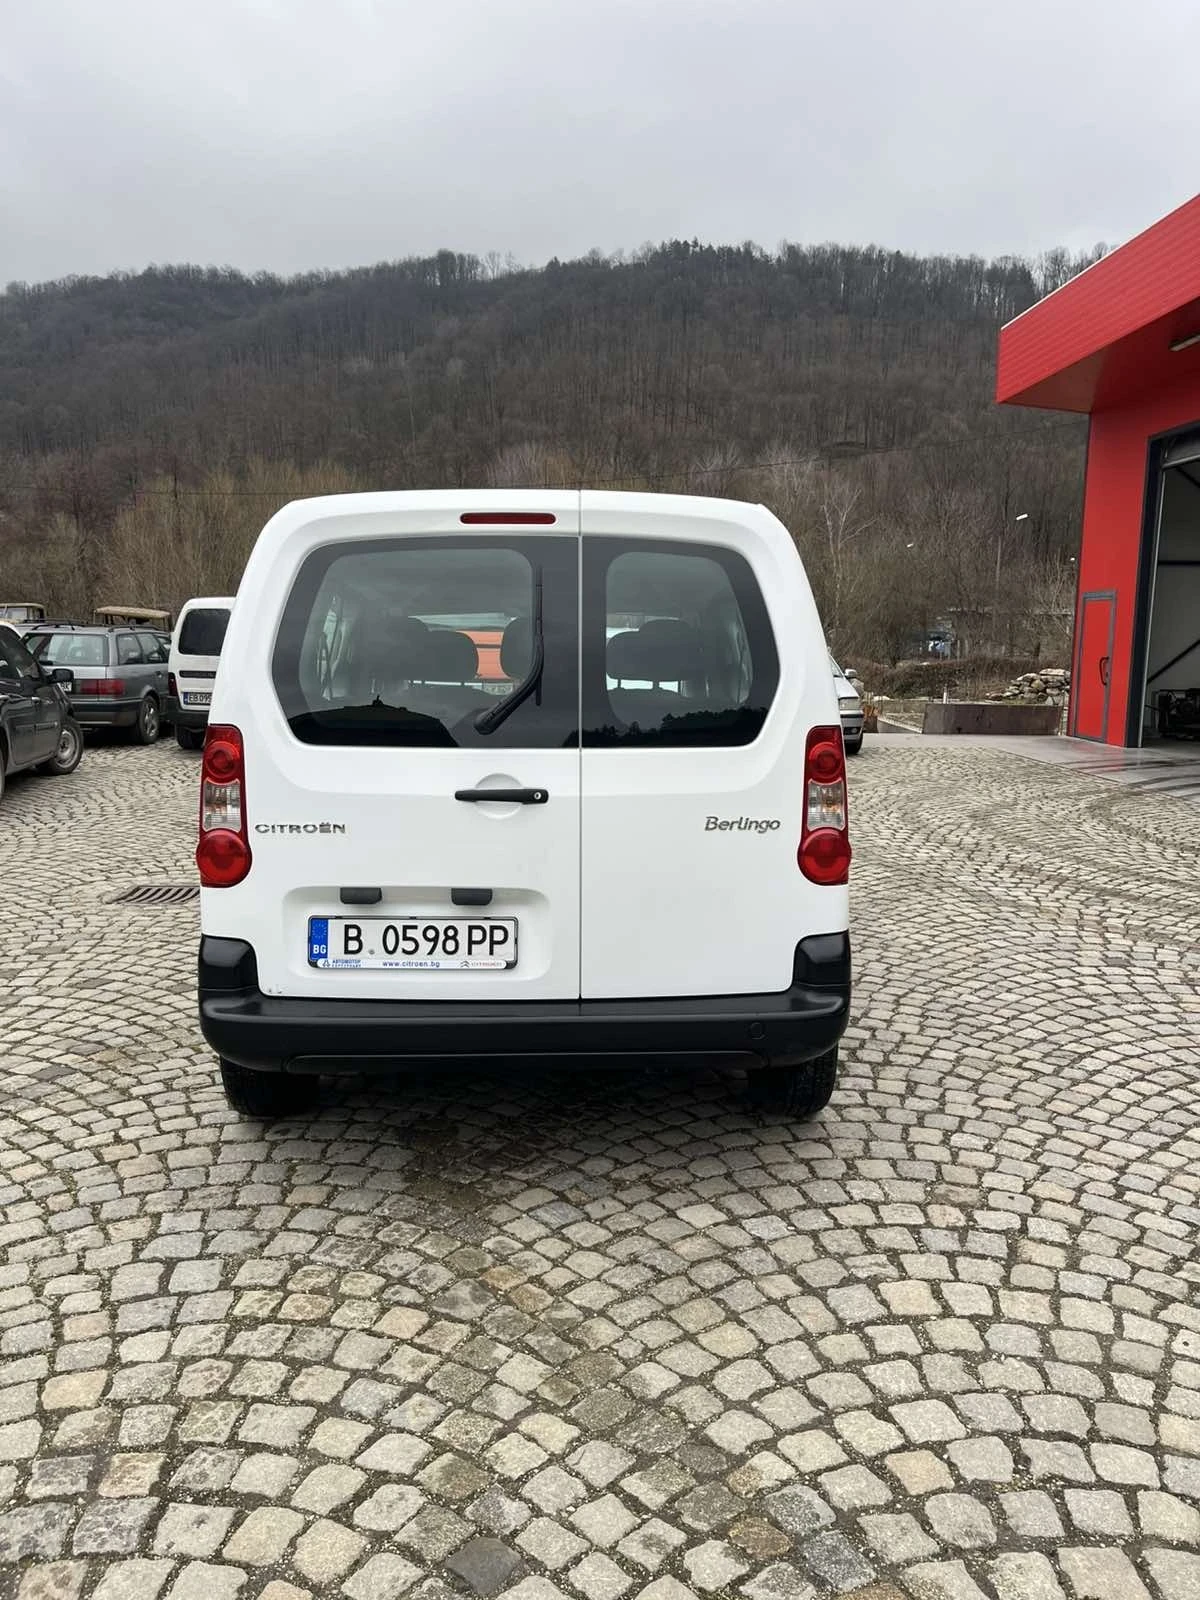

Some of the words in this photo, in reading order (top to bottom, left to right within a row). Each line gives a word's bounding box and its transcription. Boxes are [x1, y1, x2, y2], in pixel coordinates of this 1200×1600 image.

[254, 822, 346, 834] CITROËN
[704, 816, 781, 834] Berlingo
[344, 924, 363, 954] B
[382, 925, 459, 955] 0598
[467, 925, 509, 955] PP
[313, 945, 327, 954] BG
